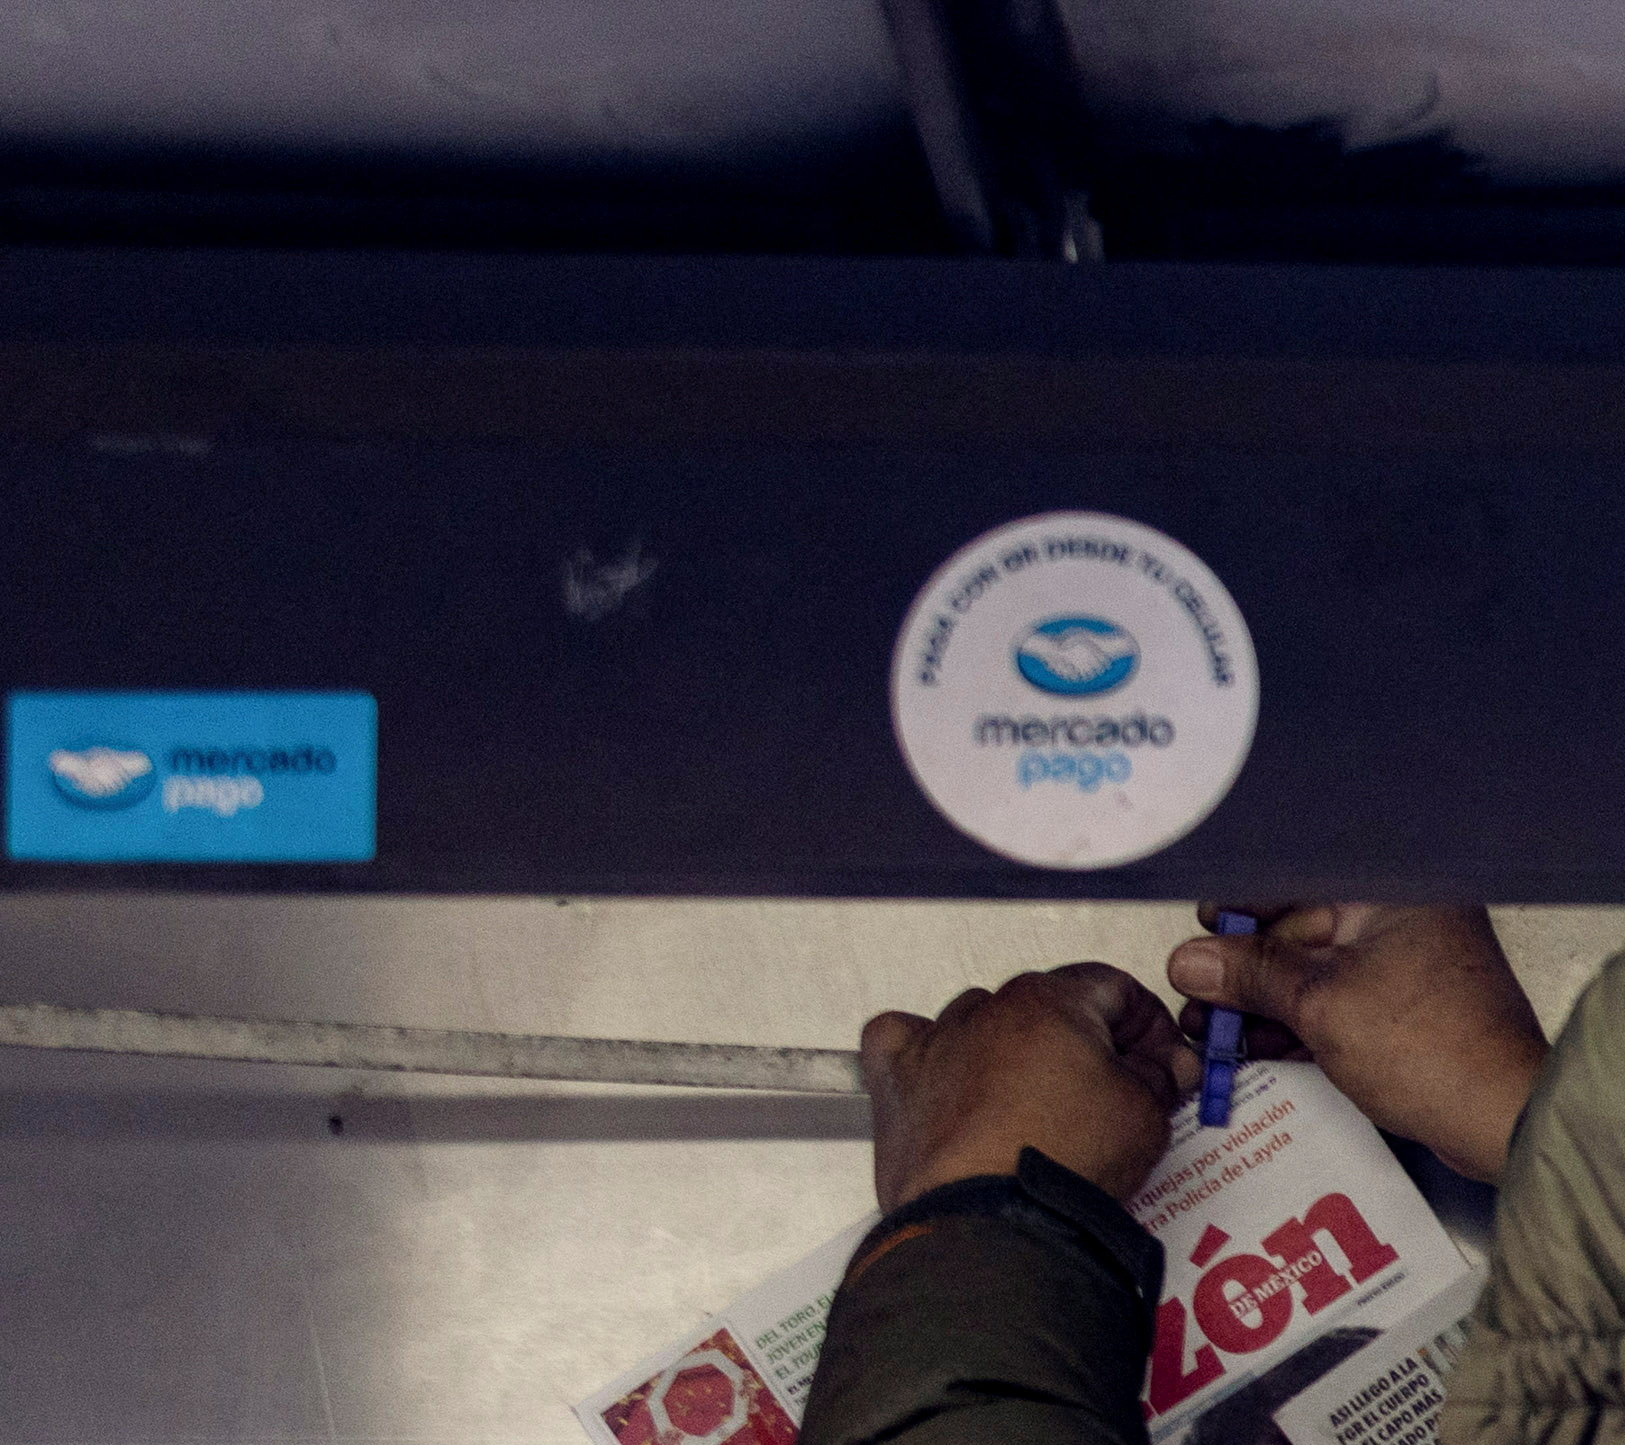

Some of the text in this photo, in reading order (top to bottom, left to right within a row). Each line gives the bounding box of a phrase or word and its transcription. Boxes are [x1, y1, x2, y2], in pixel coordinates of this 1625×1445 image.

[972, 714, 1175, 747] mercado
[172, 745, 337, 775] mercado
[1017, 752, 1132, 792] pago
[162, 774, 265, 817] pago
[1135, 1101, 1295, 1207] quejas por violación
[1163, 1132, 1292, 1219] Policía de Layda
[1146, 1193, 1398, 1418] zón
[1227, 1290, 1258, 1319] DE
